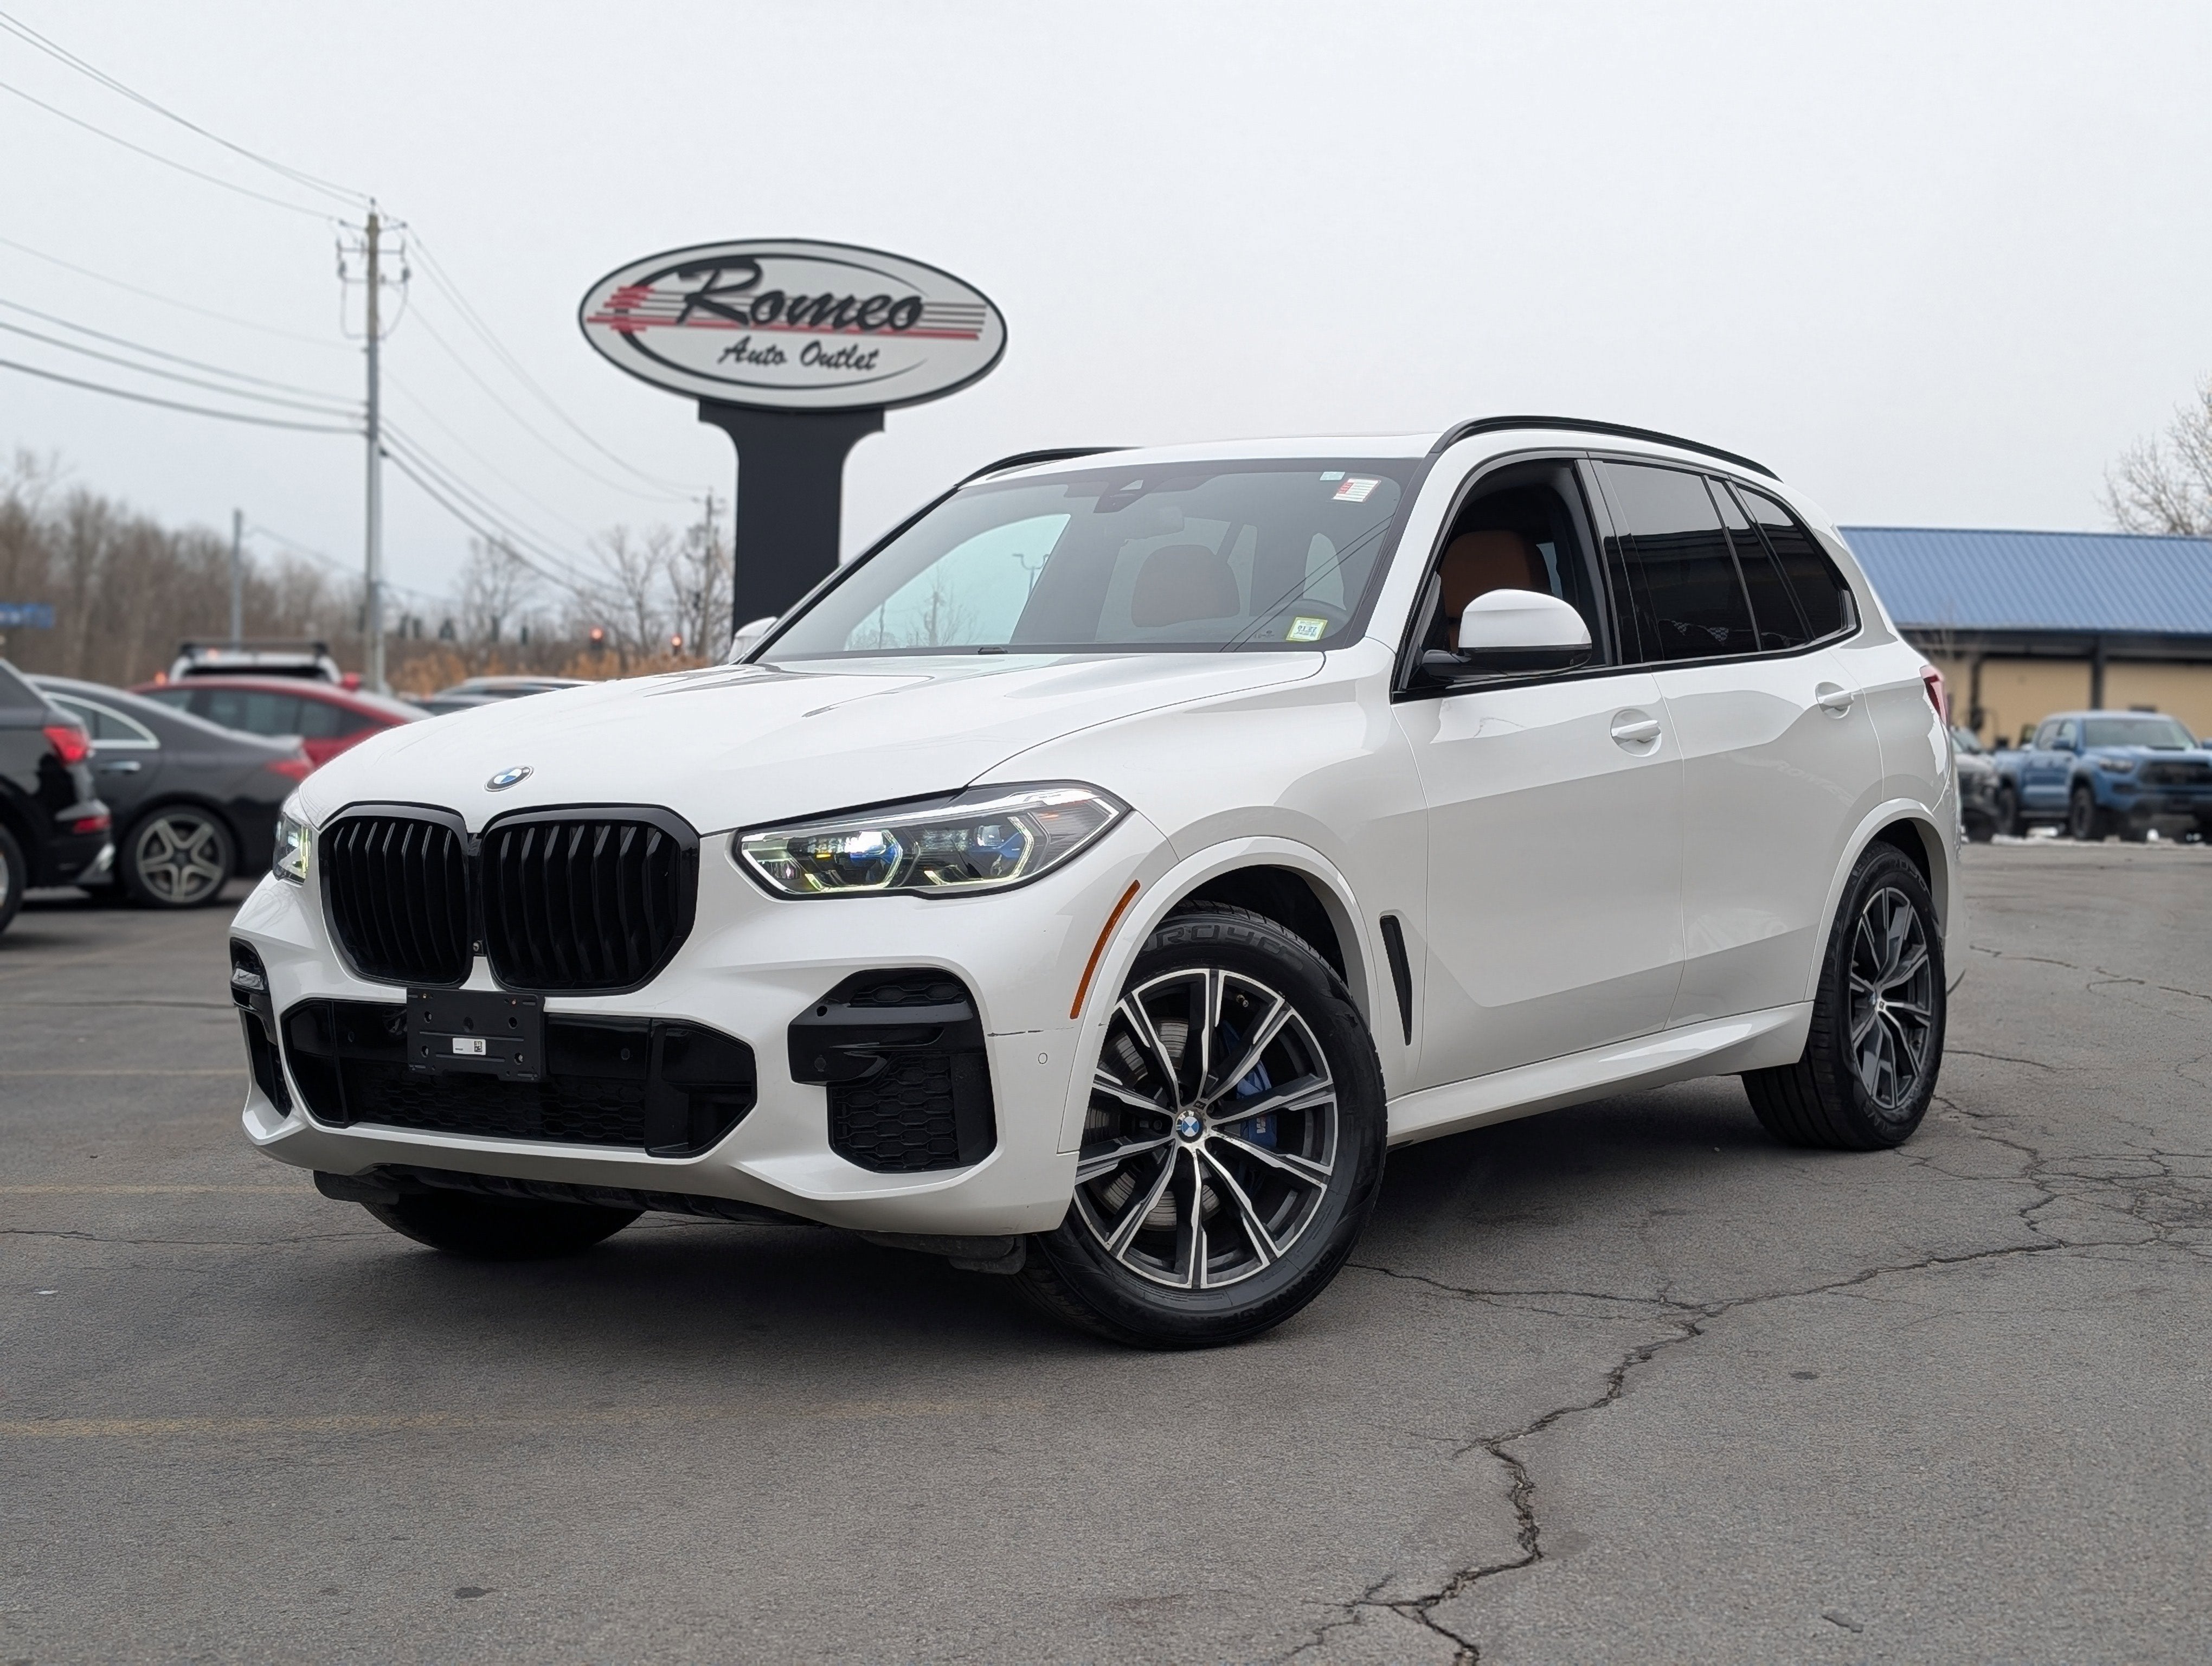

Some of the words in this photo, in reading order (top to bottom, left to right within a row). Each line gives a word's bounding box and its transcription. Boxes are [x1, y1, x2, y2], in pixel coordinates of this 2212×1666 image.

[676, 256, 923, 331] Romeo
[717, 335, 787, 365] Auto
[800, 339, 879, 370] Outlet
